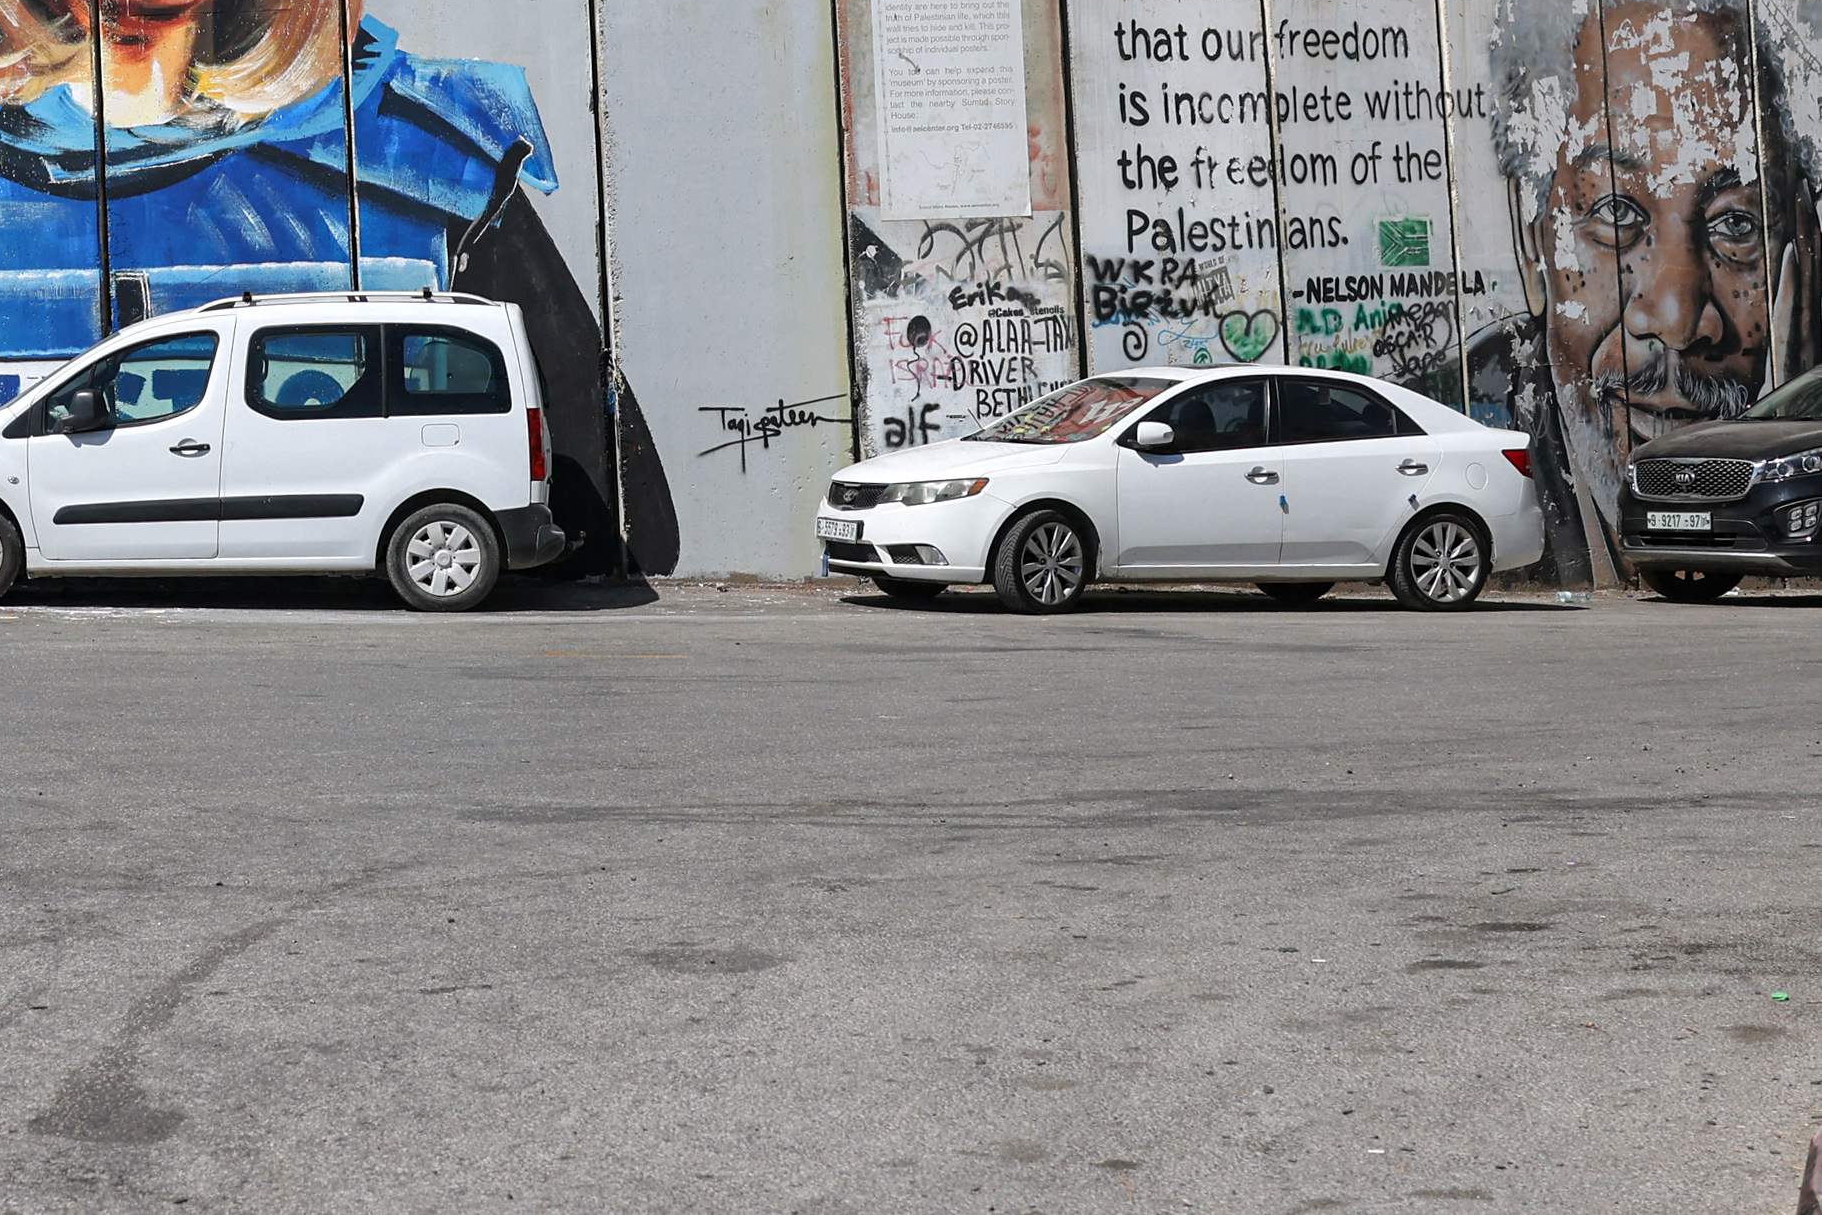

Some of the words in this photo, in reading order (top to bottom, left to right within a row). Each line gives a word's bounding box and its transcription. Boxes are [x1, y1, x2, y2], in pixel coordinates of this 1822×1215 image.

[1114, 20, 1189, 62] that
[1201, 27, 1266, 61] our
[1275, 19, 1409, 62] freedom
[1119, 83, 1150, 126] is
[1162, 83, 1352, 126] incomplete
[1364, 82, 1487, 122] without
[1117, 143, 1178, 188] the
[1190, 144, 1338, 188] freedom
[1350, 141, 1383, 183] of
[1392, 141, 1442, 183] the
[1126, 207, 1349, 254] Palestinians.
[1390, 270, 1486, 299] MANDELA
[1675, 473, 1691, 483] KIA
